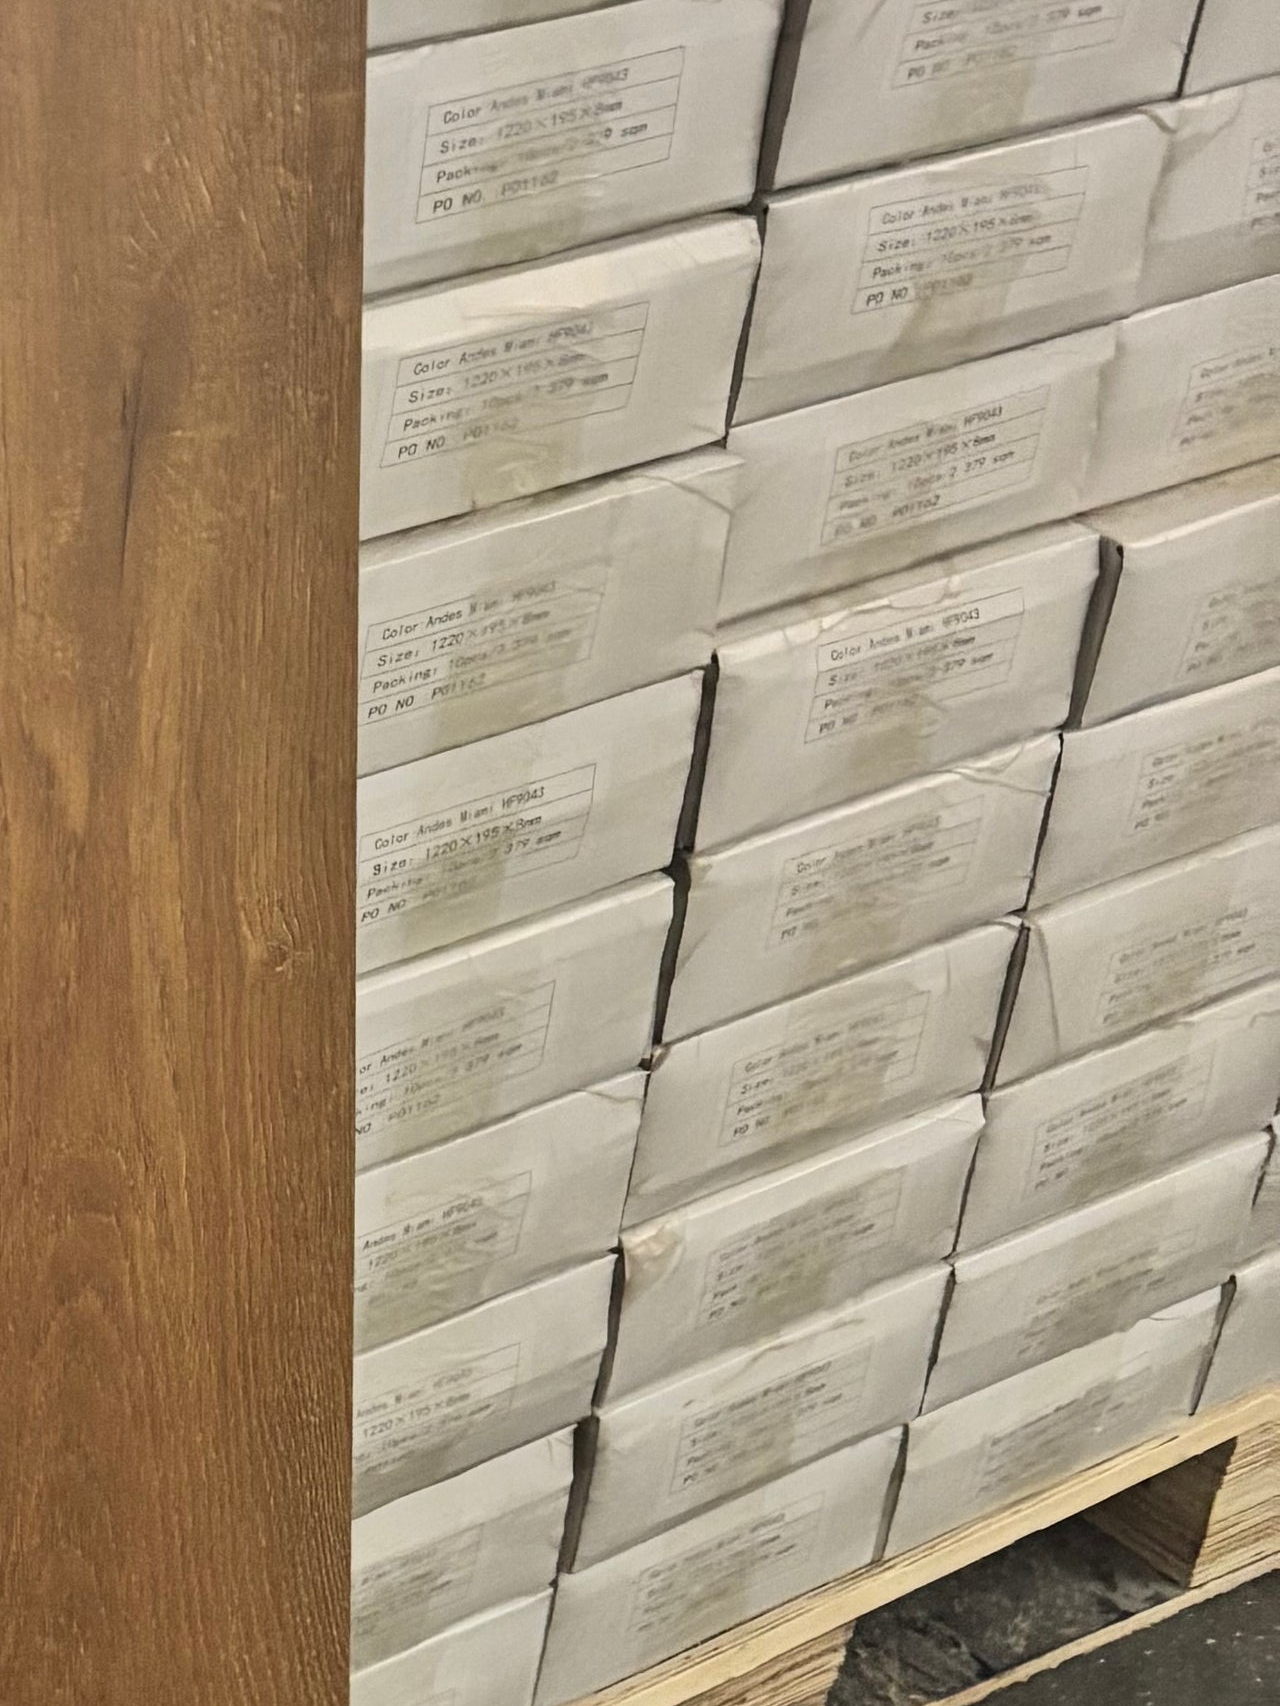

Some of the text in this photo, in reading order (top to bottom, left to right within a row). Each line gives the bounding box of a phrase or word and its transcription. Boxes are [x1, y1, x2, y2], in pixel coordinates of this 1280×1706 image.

[443, 106, 482, 124] Color
[432, 197, 453, 214] PO
[866, 292, 884, 307] PO
[398, 444, 418, 458] PO
[382, 610, 463, 640] Color Andes
[377, 650, 420, 667] Size:
[373, 667, 438, 693] Packing:
[368, 703, 388, 719] PO
[395, 695, 415, 711] NO
[375, 831, 409, 850] Color
[501, 786, 545, 810] HF9043
[361, 908, 379, 922] PO
